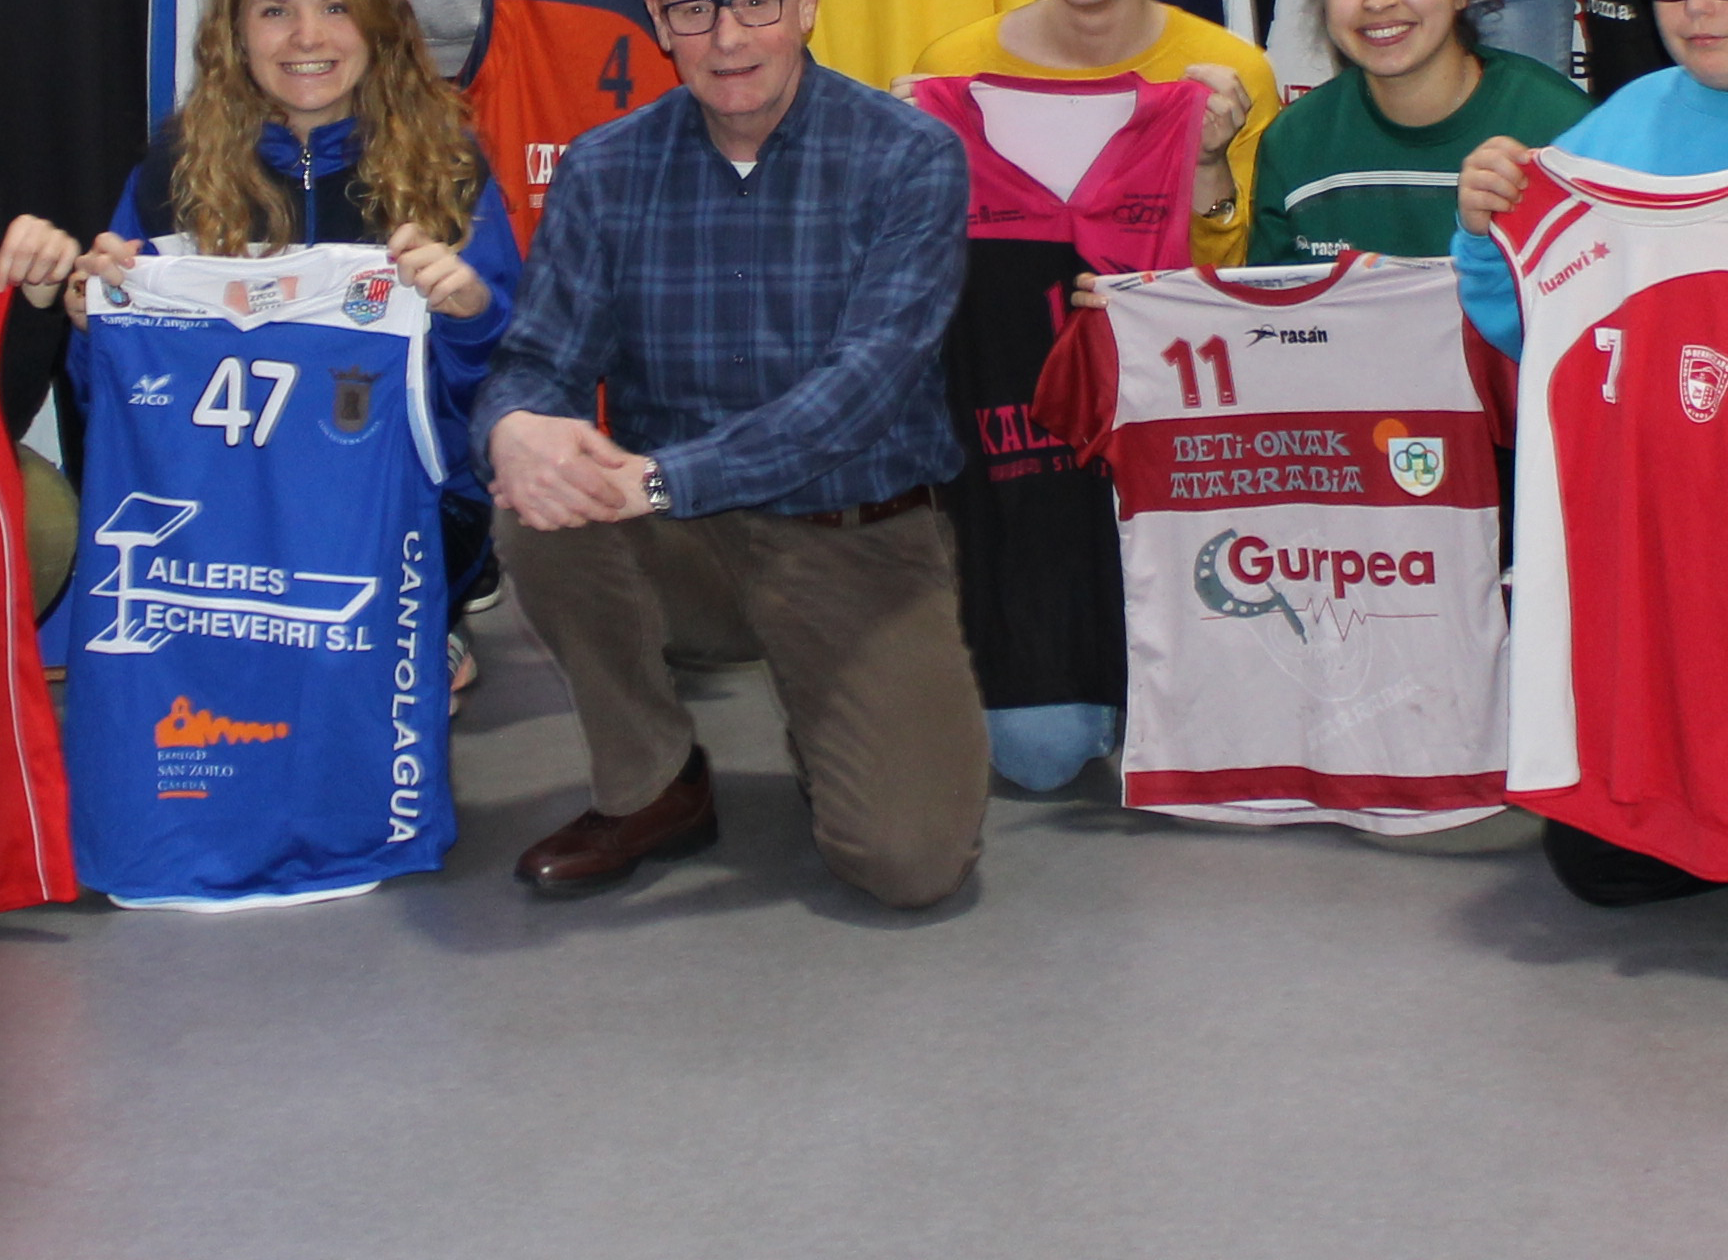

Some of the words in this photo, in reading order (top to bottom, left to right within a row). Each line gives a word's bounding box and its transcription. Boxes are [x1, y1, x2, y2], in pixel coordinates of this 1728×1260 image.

[598, 35, 634, 110] 4
[1538, 251, 1591, 296] luanvi
[1280, 326, 1328, 345] rasán
[1594, 327, 1623, 405] 7
[128, 394, 169, 406] ZICO
[192, 356, 297, 447] 47
[1160, 334, 1237, 408] 11
[1228, 534, 1437, 601] Gurpea
[145, 602, 316, 650] ECHEVERRI
[386, 531, 422, 844] CANTOLAGUA
[157, 765, 185, 776] SAN
